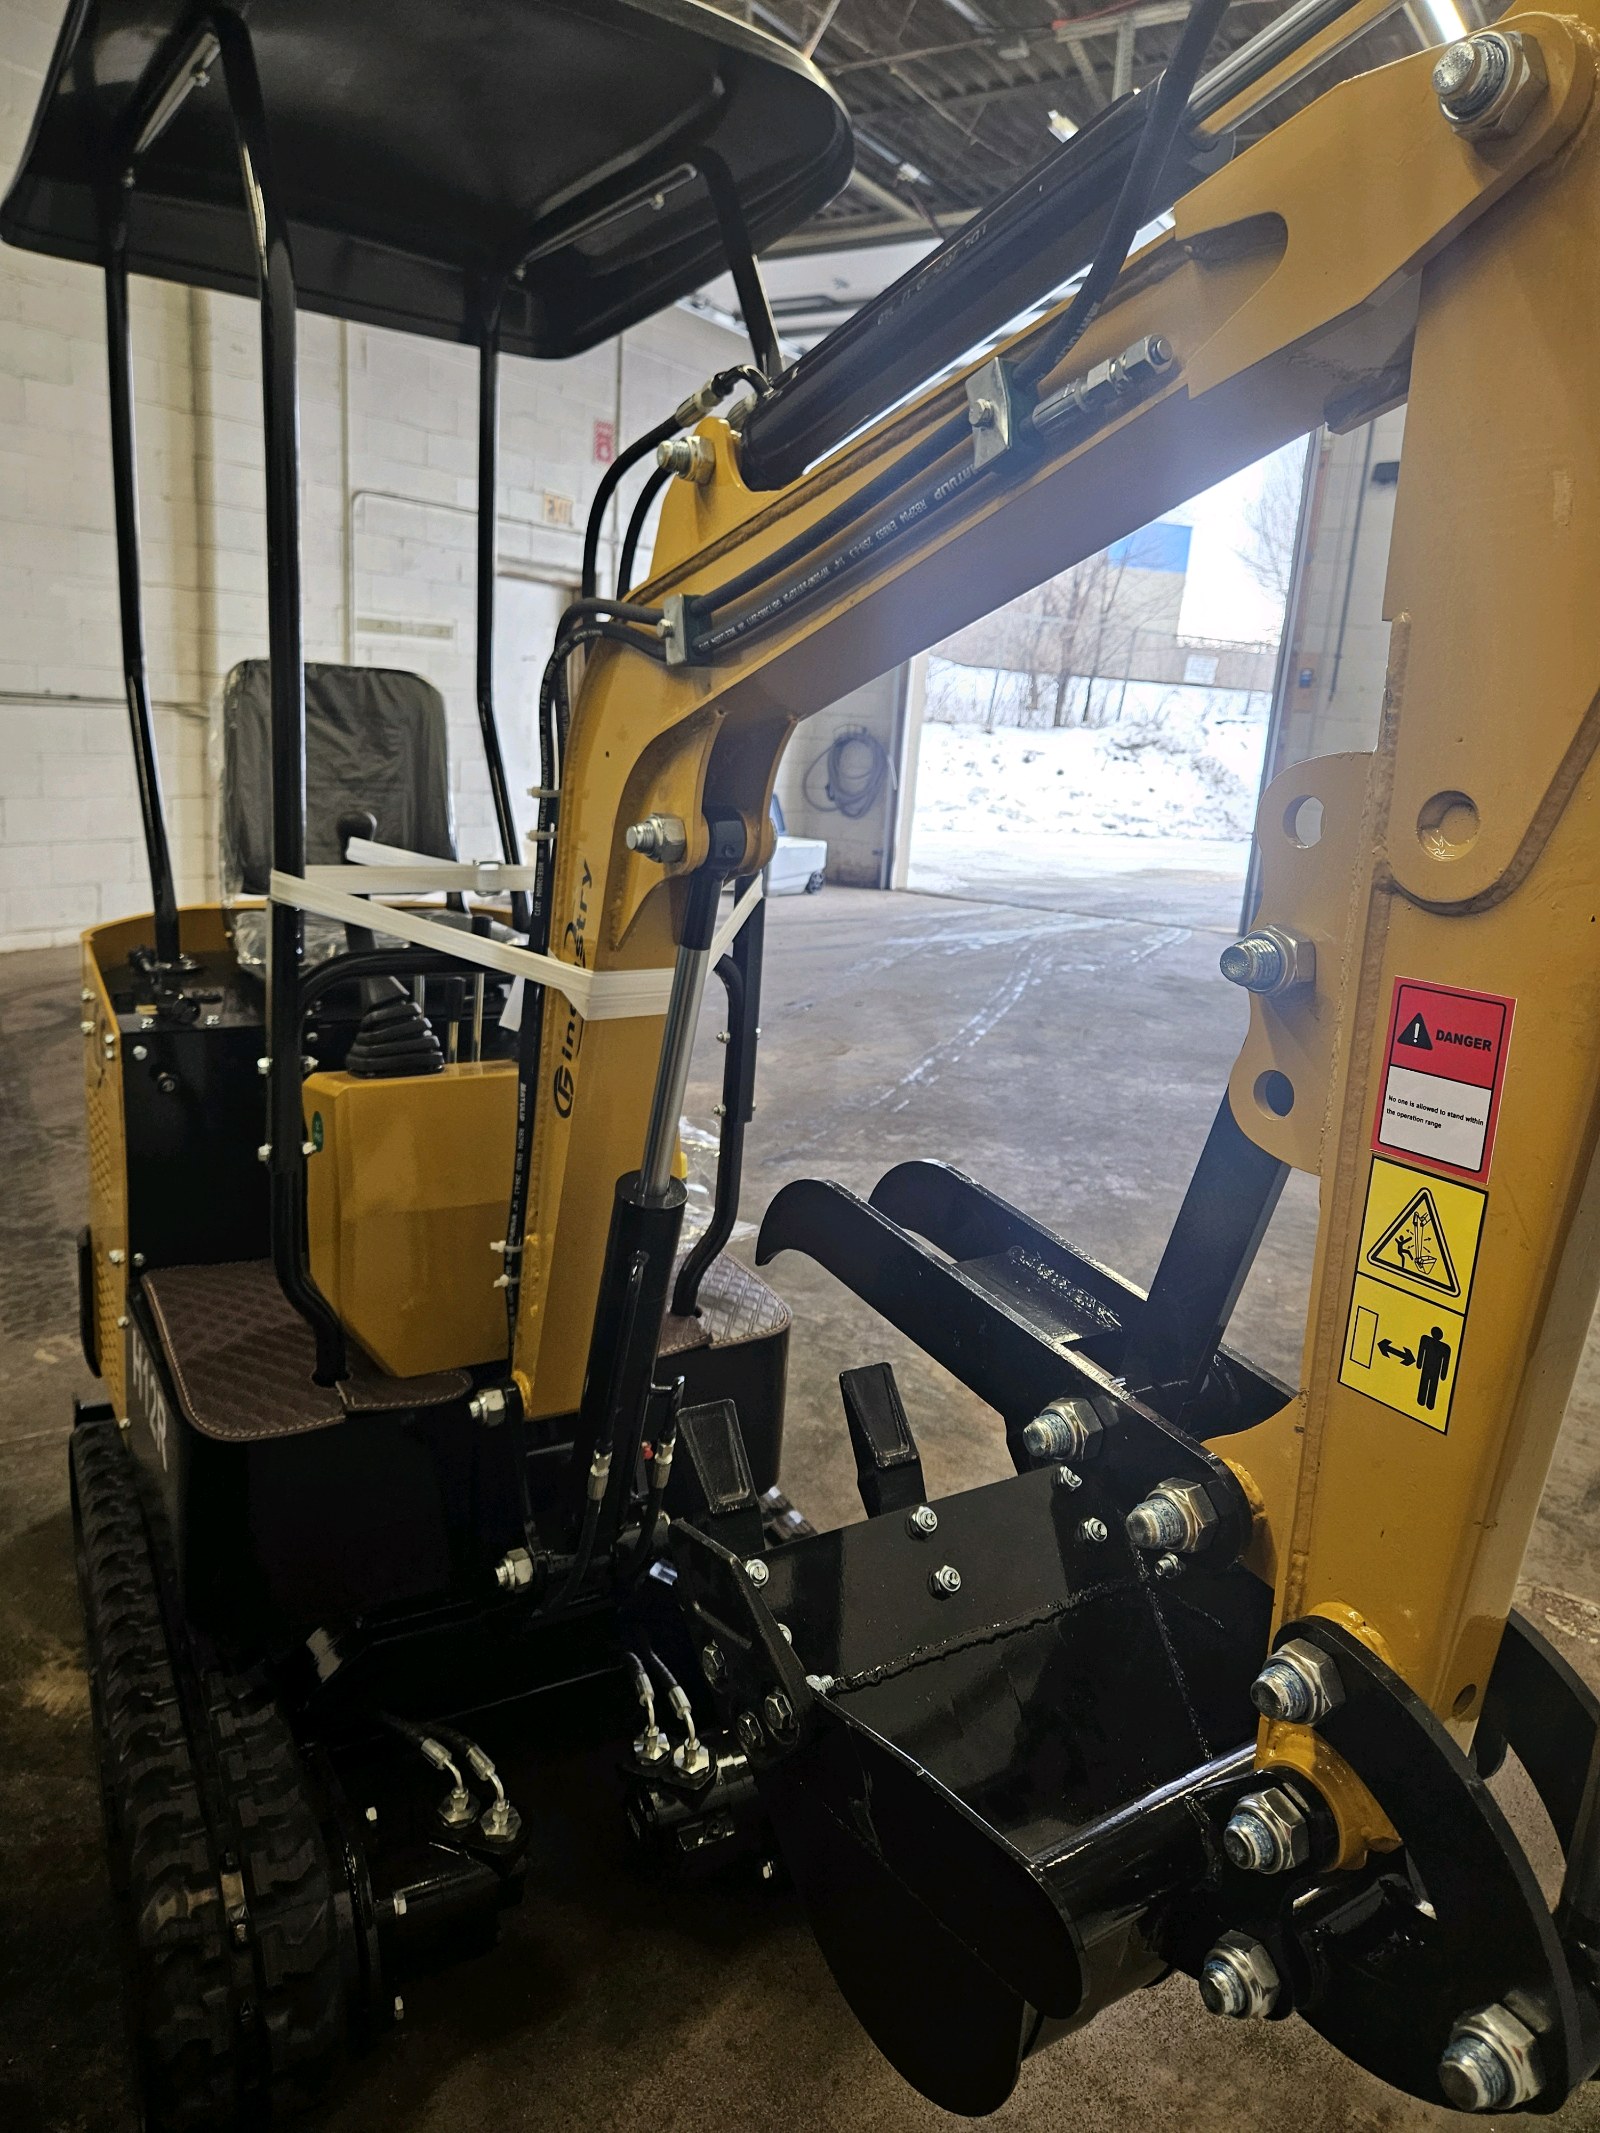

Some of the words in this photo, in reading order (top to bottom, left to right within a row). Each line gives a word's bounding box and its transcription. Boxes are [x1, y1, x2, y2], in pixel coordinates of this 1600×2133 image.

[1435, 1029, 1492, 1052] DANGER
[1386, 1108, 1396, 1116] the
[1397, 1111, 1424, 1124] operation
[1425, 1119, 1442, 1129] range
[1388, 1095, 1397, 1103] No
[1398, 1097, 1409, 1106] one
[1416, 1103, 1439, 1114] allowed
[1447, 1111, 1464, 1121] stand
[1465, 1116, 1484, 1126] within
